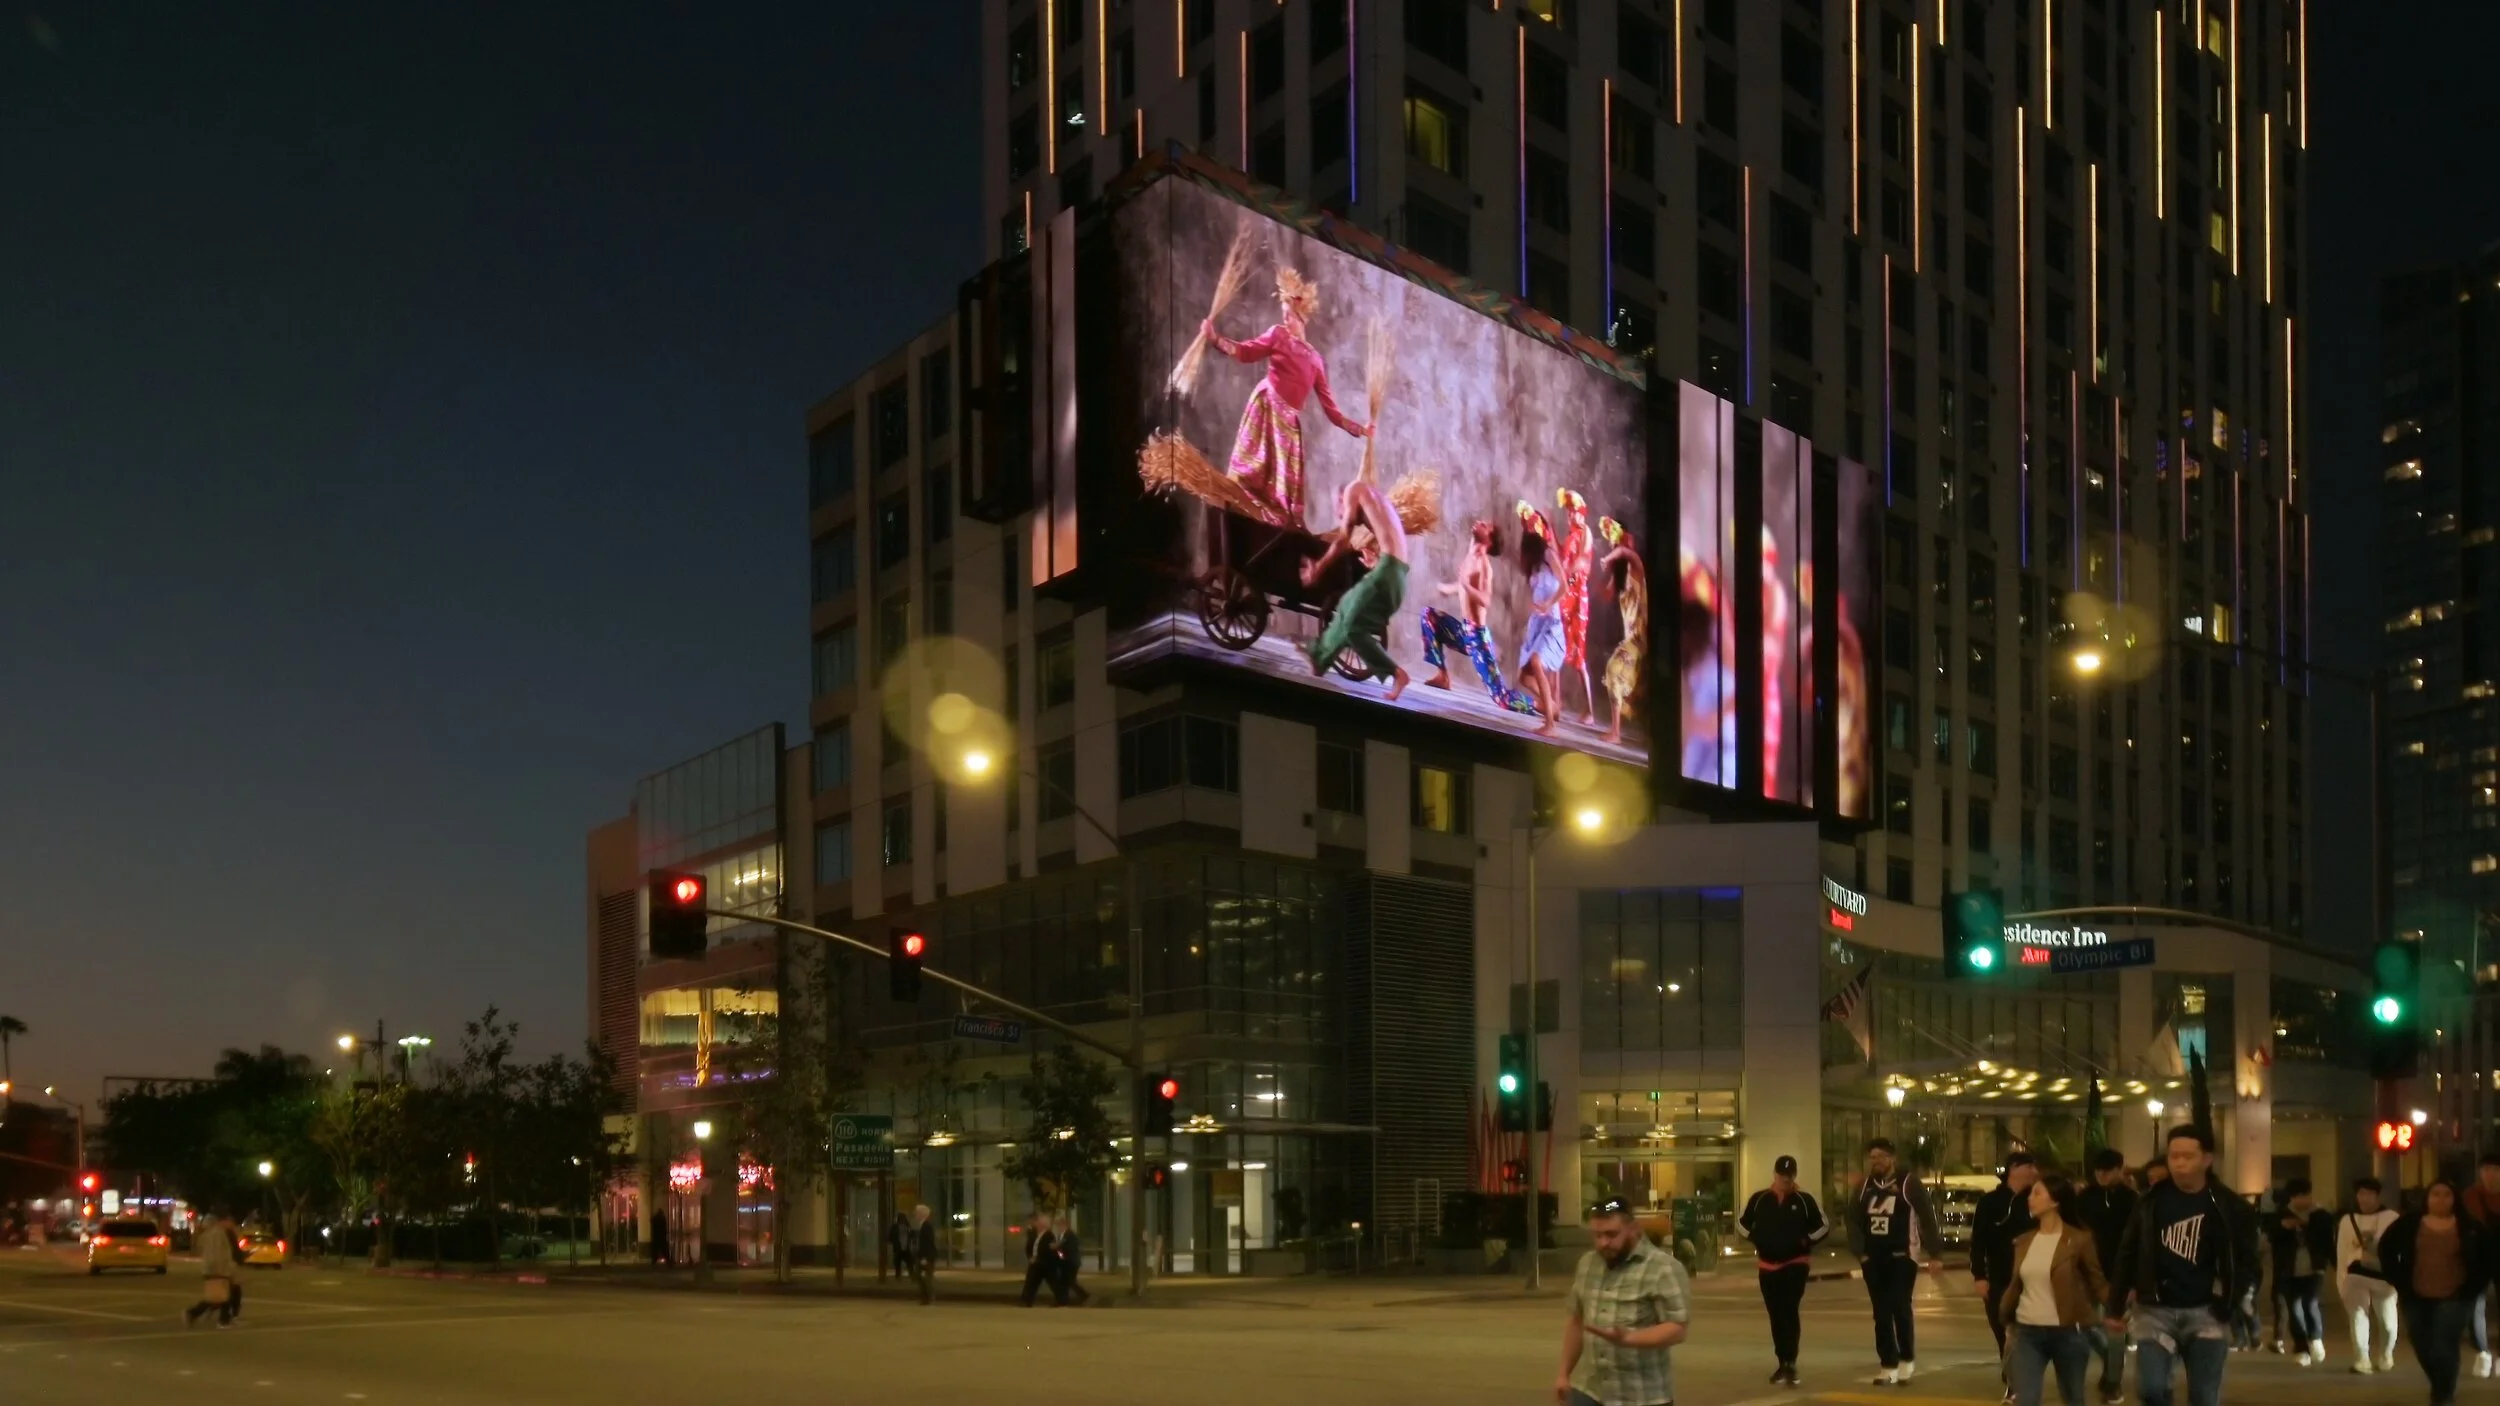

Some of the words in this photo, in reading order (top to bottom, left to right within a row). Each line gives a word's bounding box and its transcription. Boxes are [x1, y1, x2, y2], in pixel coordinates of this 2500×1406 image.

[1823, 874, 1866, 916] COURTYARD
[2003, 923, 2070, 947] sidence
[2072, 926, 2107, 946] Inn
[2021, 947, 2050, 964] Marr
[2058, 948, 2123, 969] Olympic
[957, 1018, 1004, 1037] Francisco
[839, 1125, 854, 1137] 110
[836, 1143, 891, 1153] Pasadena
[1867, 1195, 1897, 1215] LA
[1871, 1216, 1889, 1235] 23
